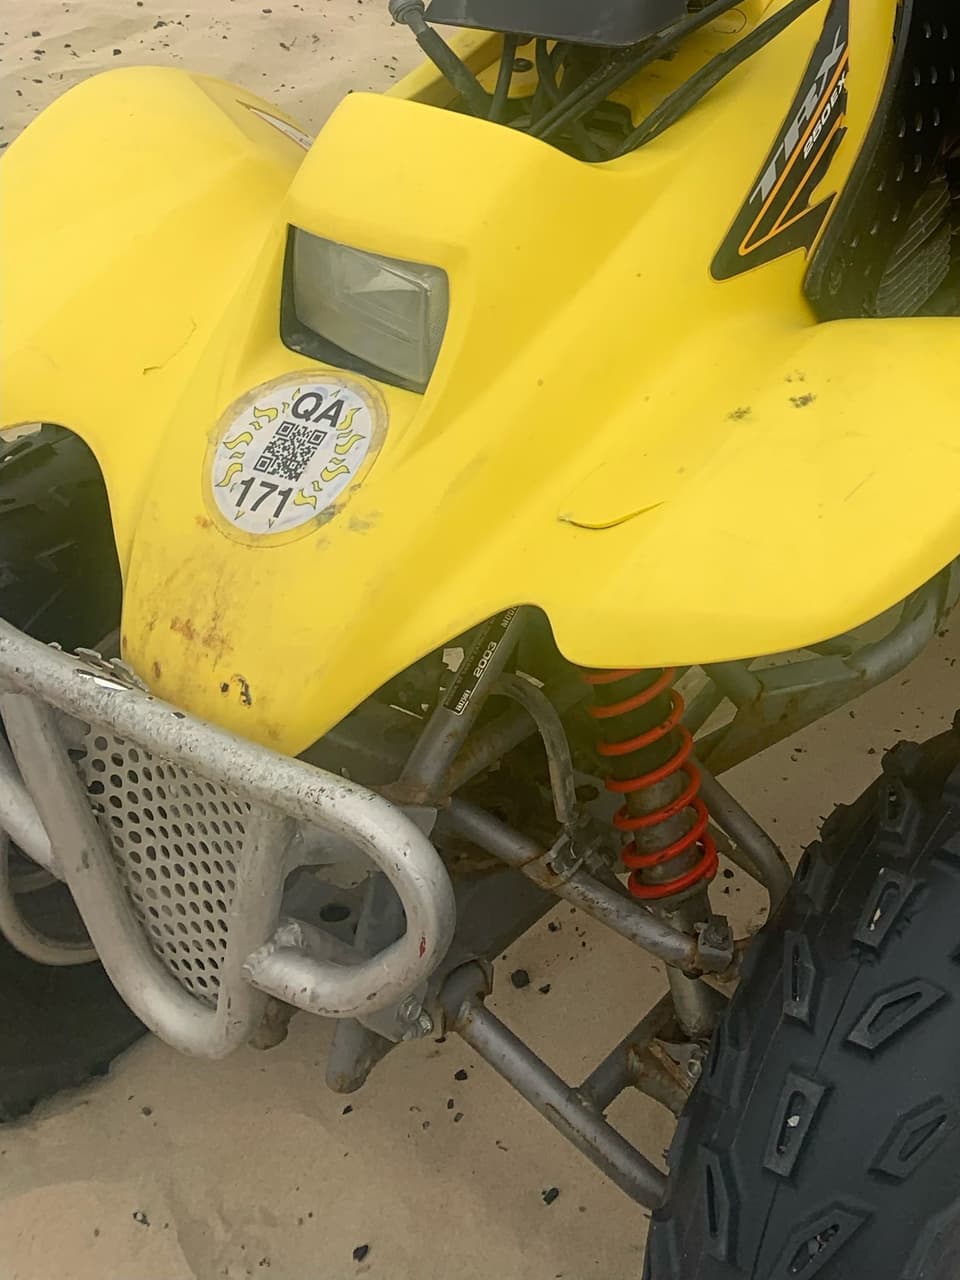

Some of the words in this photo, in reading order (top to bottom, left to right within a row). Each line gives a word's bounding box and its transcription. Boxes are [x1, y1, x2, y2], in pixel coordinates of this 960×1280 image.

[749, 24, 846, 205] TRX
[803, 70, 847, 160] 250EX
[291, 391, 345, 428] QA
[235, 476, 293, 519] 171
[472, 641, 497, 678] 2003
